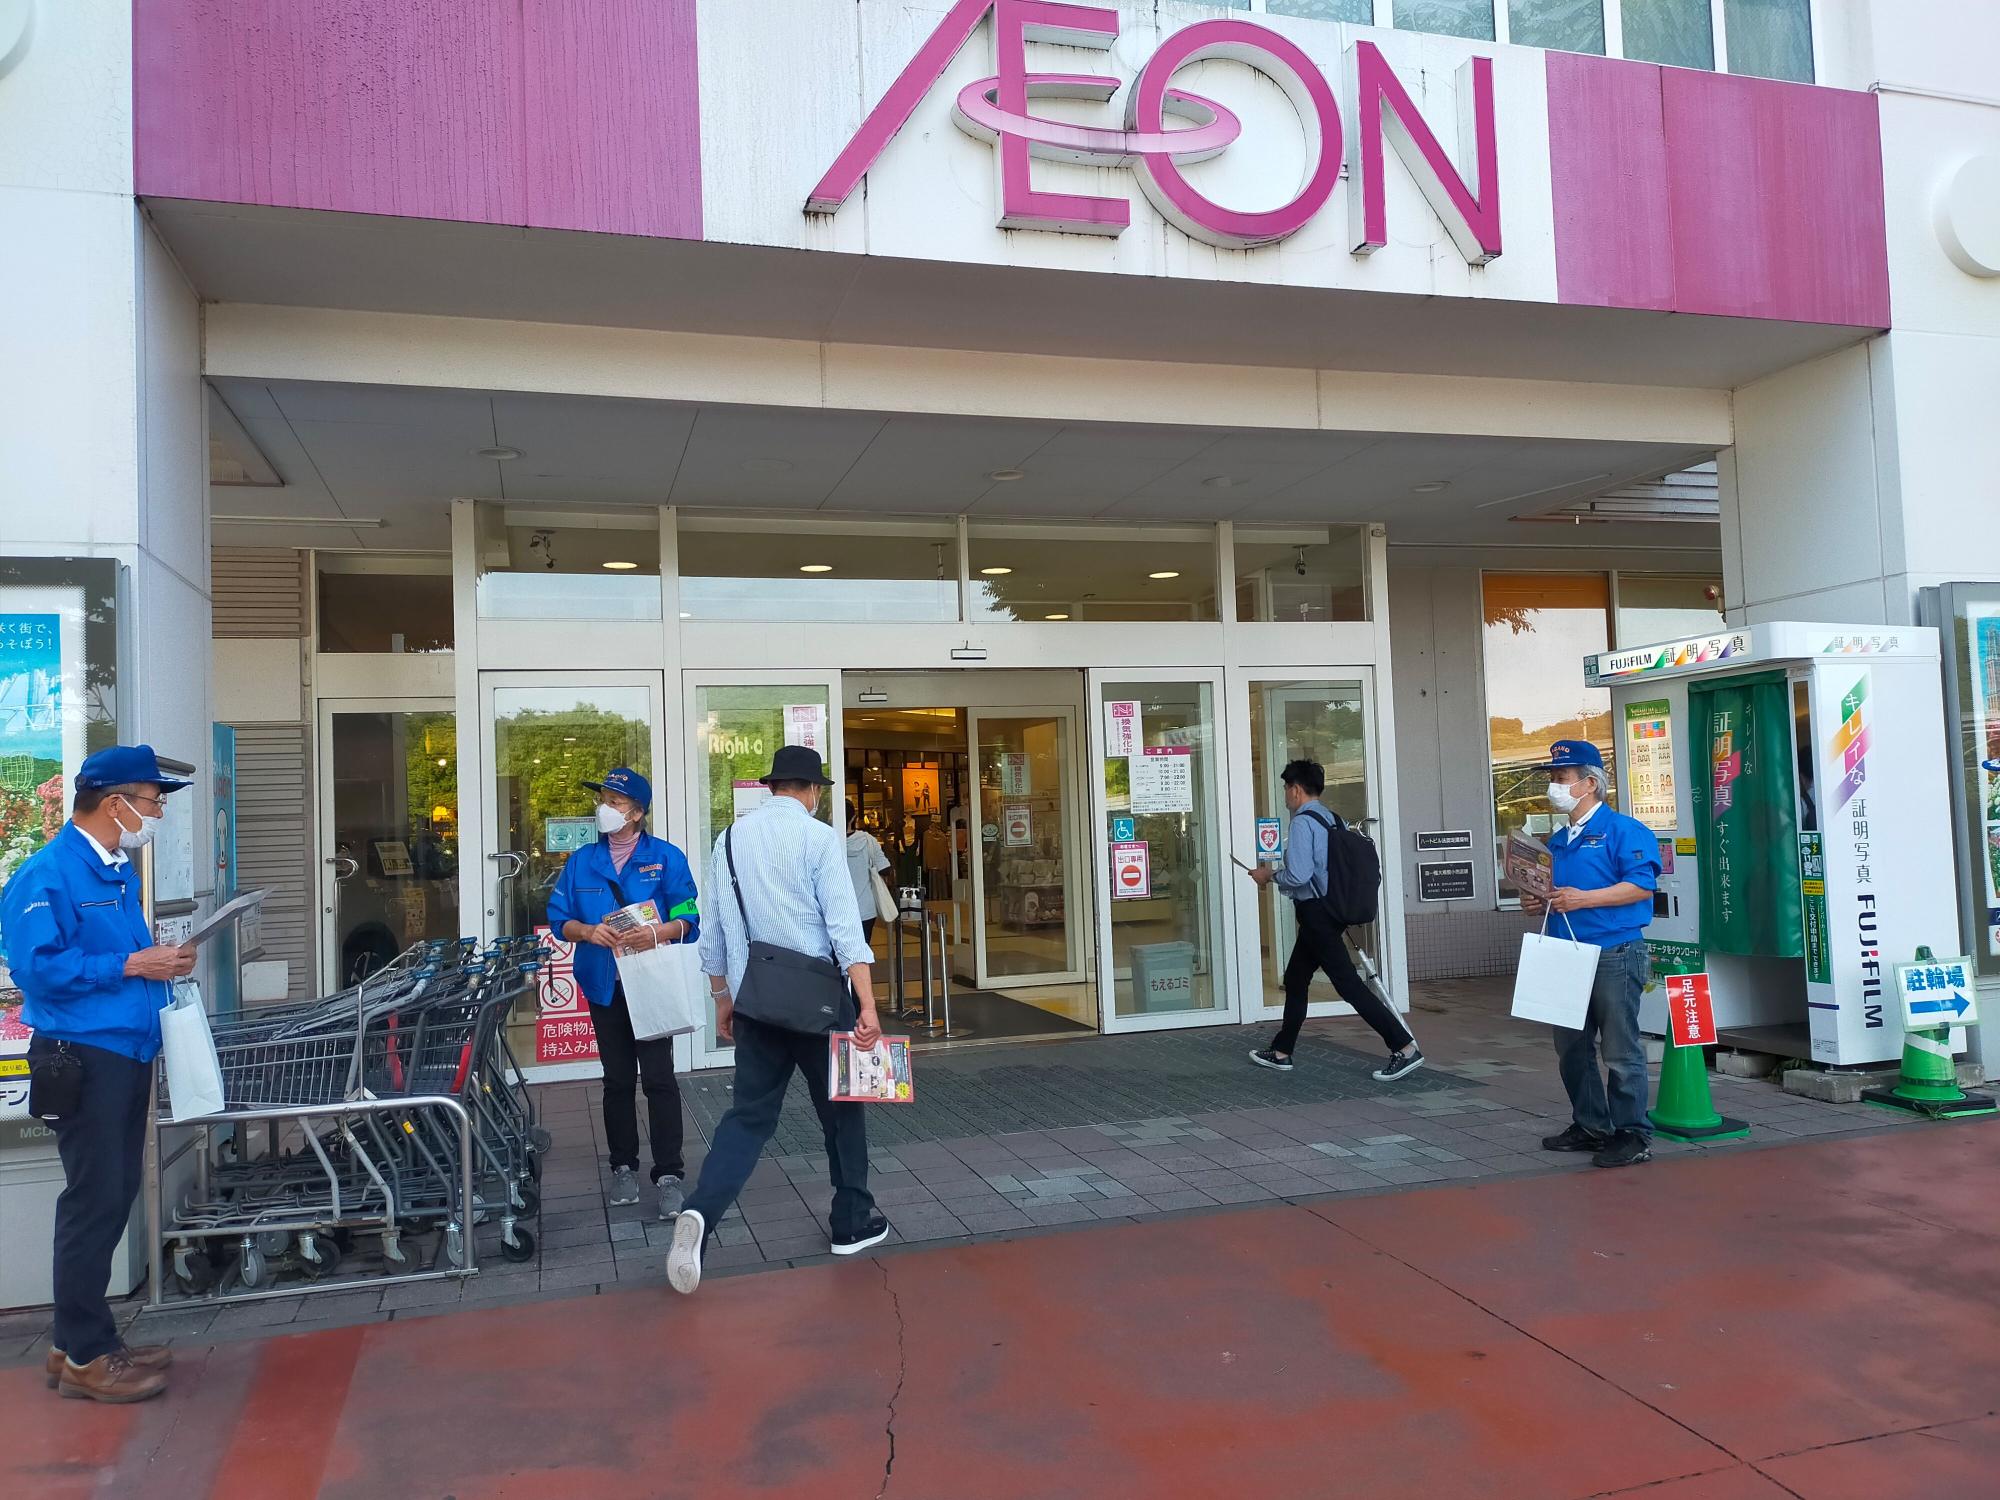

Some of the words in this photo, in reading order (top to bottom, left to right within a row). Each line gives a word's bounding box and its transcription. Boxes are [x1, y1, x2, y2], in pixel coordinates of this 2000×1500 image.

[1610, 653, 1652, 670] FUJIFILM
[1664, 635, 1744, 666] 証明写真
[1833, 636, 1899, 650] 証明写真
[1121, 718, 1132, 755] 換気強化中
[1713, 711, 1733, 807] 証明写真
[1744, 703, 1753, 775] キレイな
[1846, 693, 1864, 785] キレイな
[1117, 855, 1144, 864] 出口専用
[1851, 798, 1872, 884] 証明写真
[1716, 821, 1733, 924] すぐ出来ます
[1151, 976, 1189, 992] もえるゴミ
[1857, 894, 1884, 1029] FUJIFILM
[1904, 965, 1965, 992] 駐輪場
[1682, 979, 1701, 1039] 足元注意
